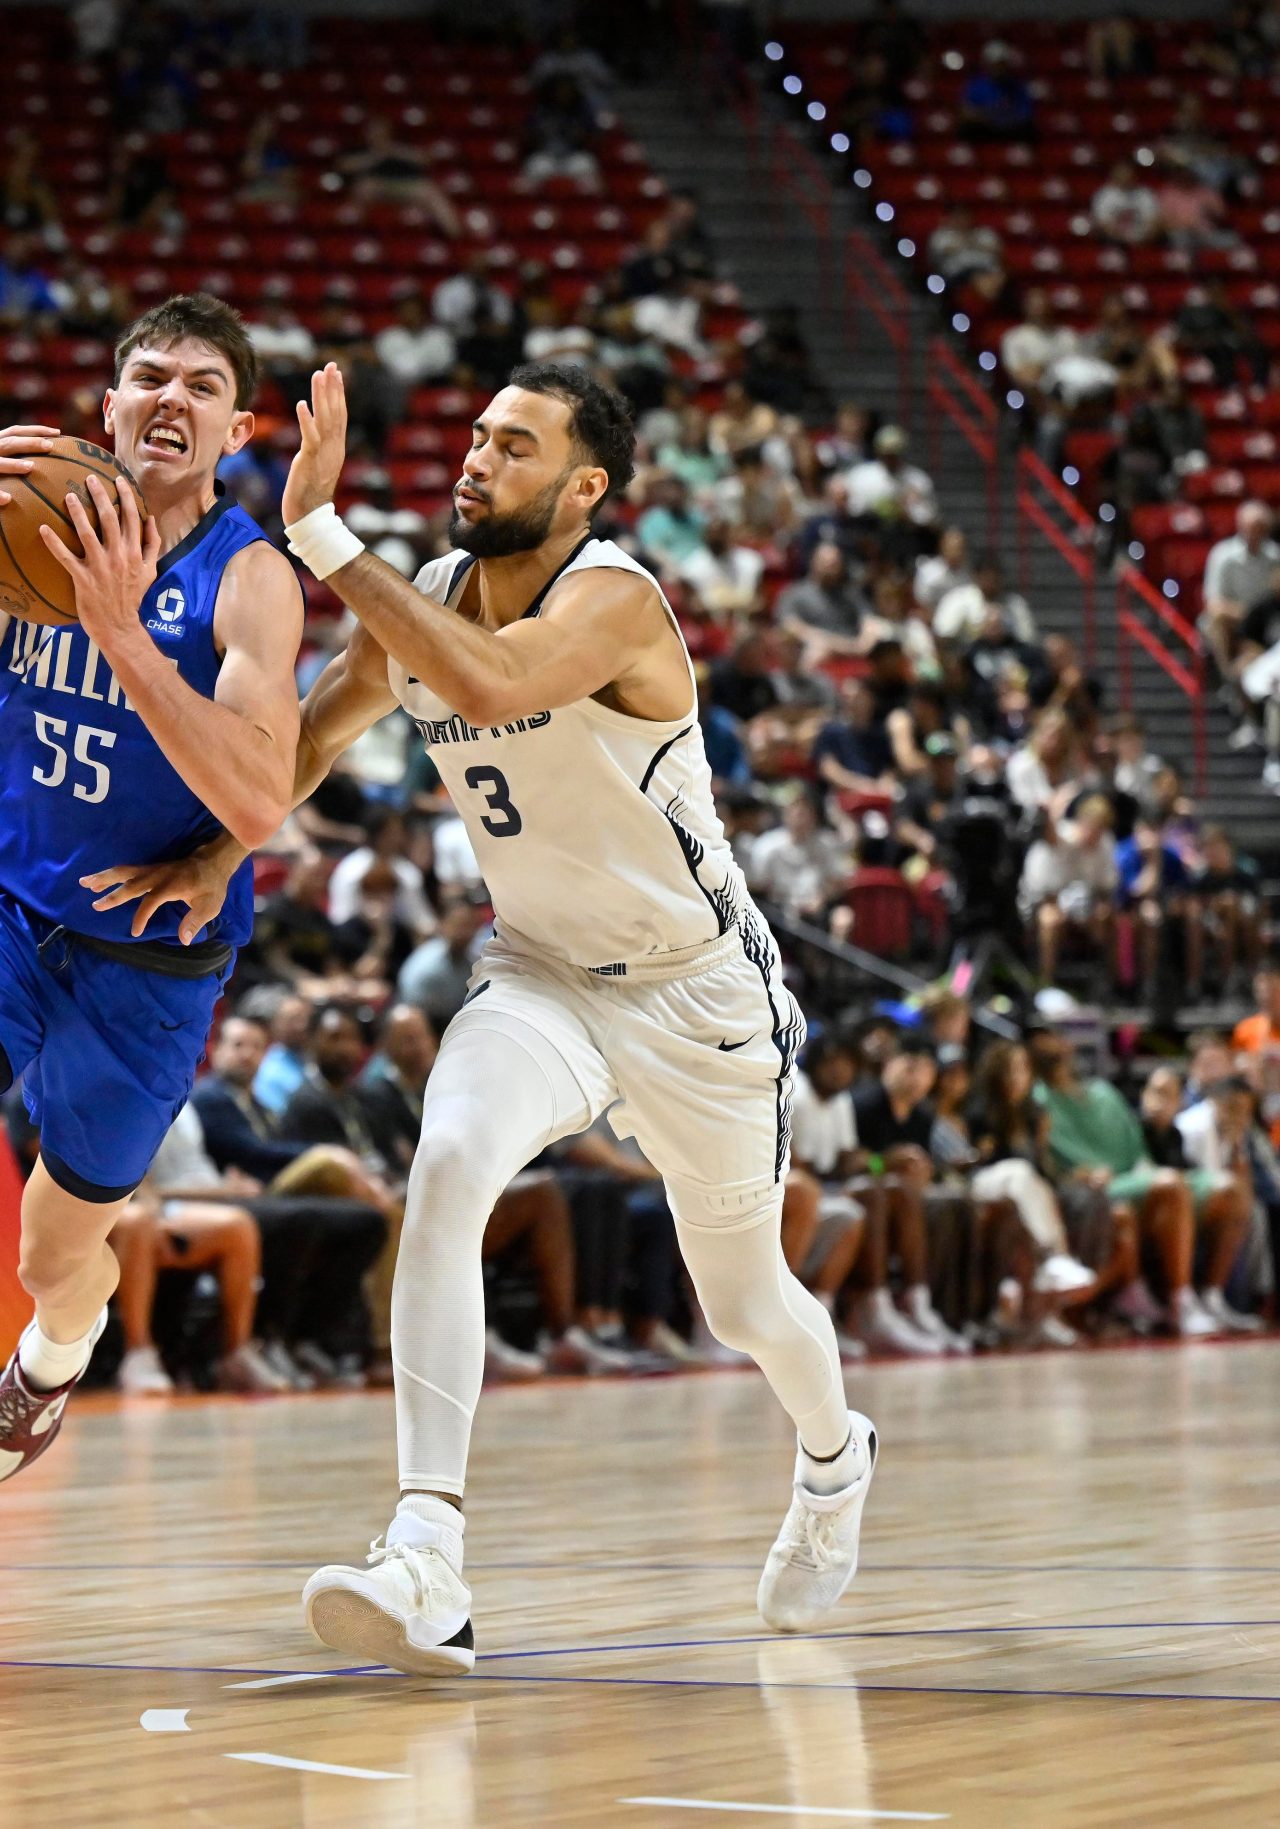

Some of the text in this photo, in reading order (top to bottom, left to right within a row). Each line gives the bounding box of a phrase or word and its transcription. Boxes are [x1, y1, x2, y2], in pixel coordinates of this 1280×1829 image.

[8, 620, 179, 712] DALL
[147, 619, 183, 636] CHASE
[32, 710, 117, 804] 55
[464, 764, 523, 838] 3
